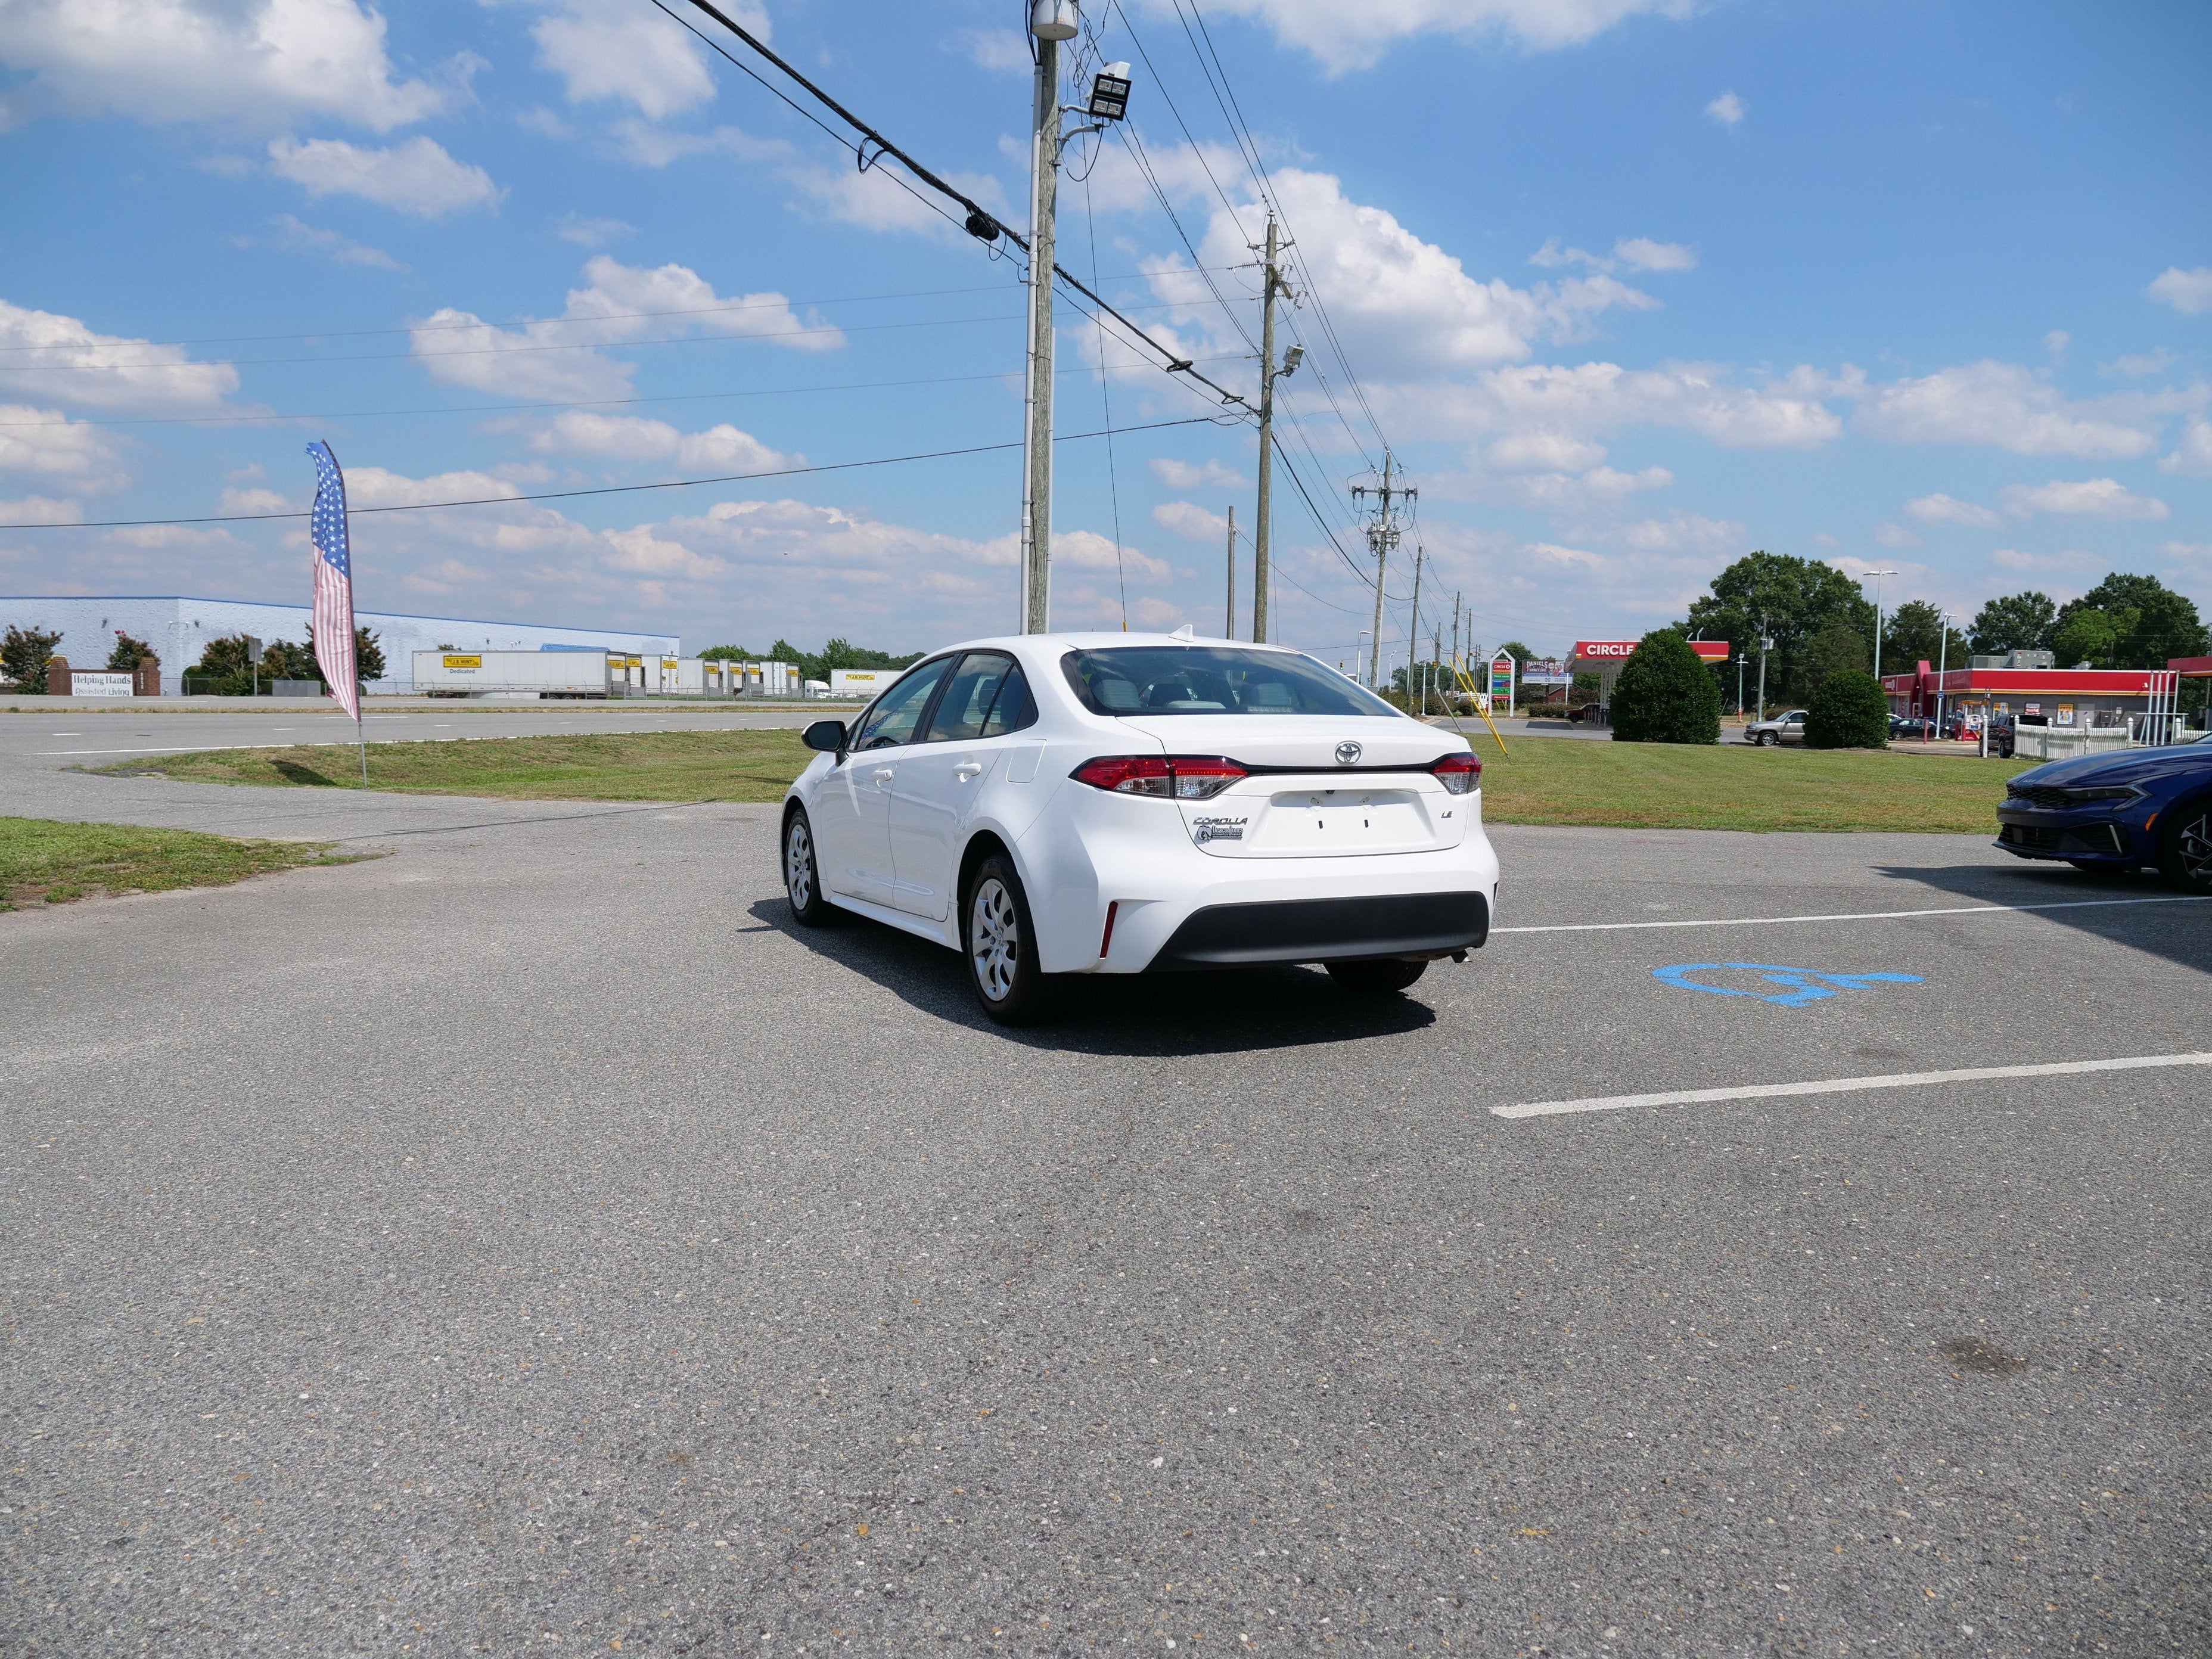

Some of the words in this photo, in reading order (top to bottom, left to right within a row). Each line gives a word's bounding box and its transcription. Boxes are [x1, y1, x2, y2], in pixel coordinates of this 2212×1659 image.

[1586, 645, 1634, 655] CIRCLE
[73, 675, 104, 685] Helping
[105, 675, 131, 685] Hands
[108, 688, 129, 696] Living
